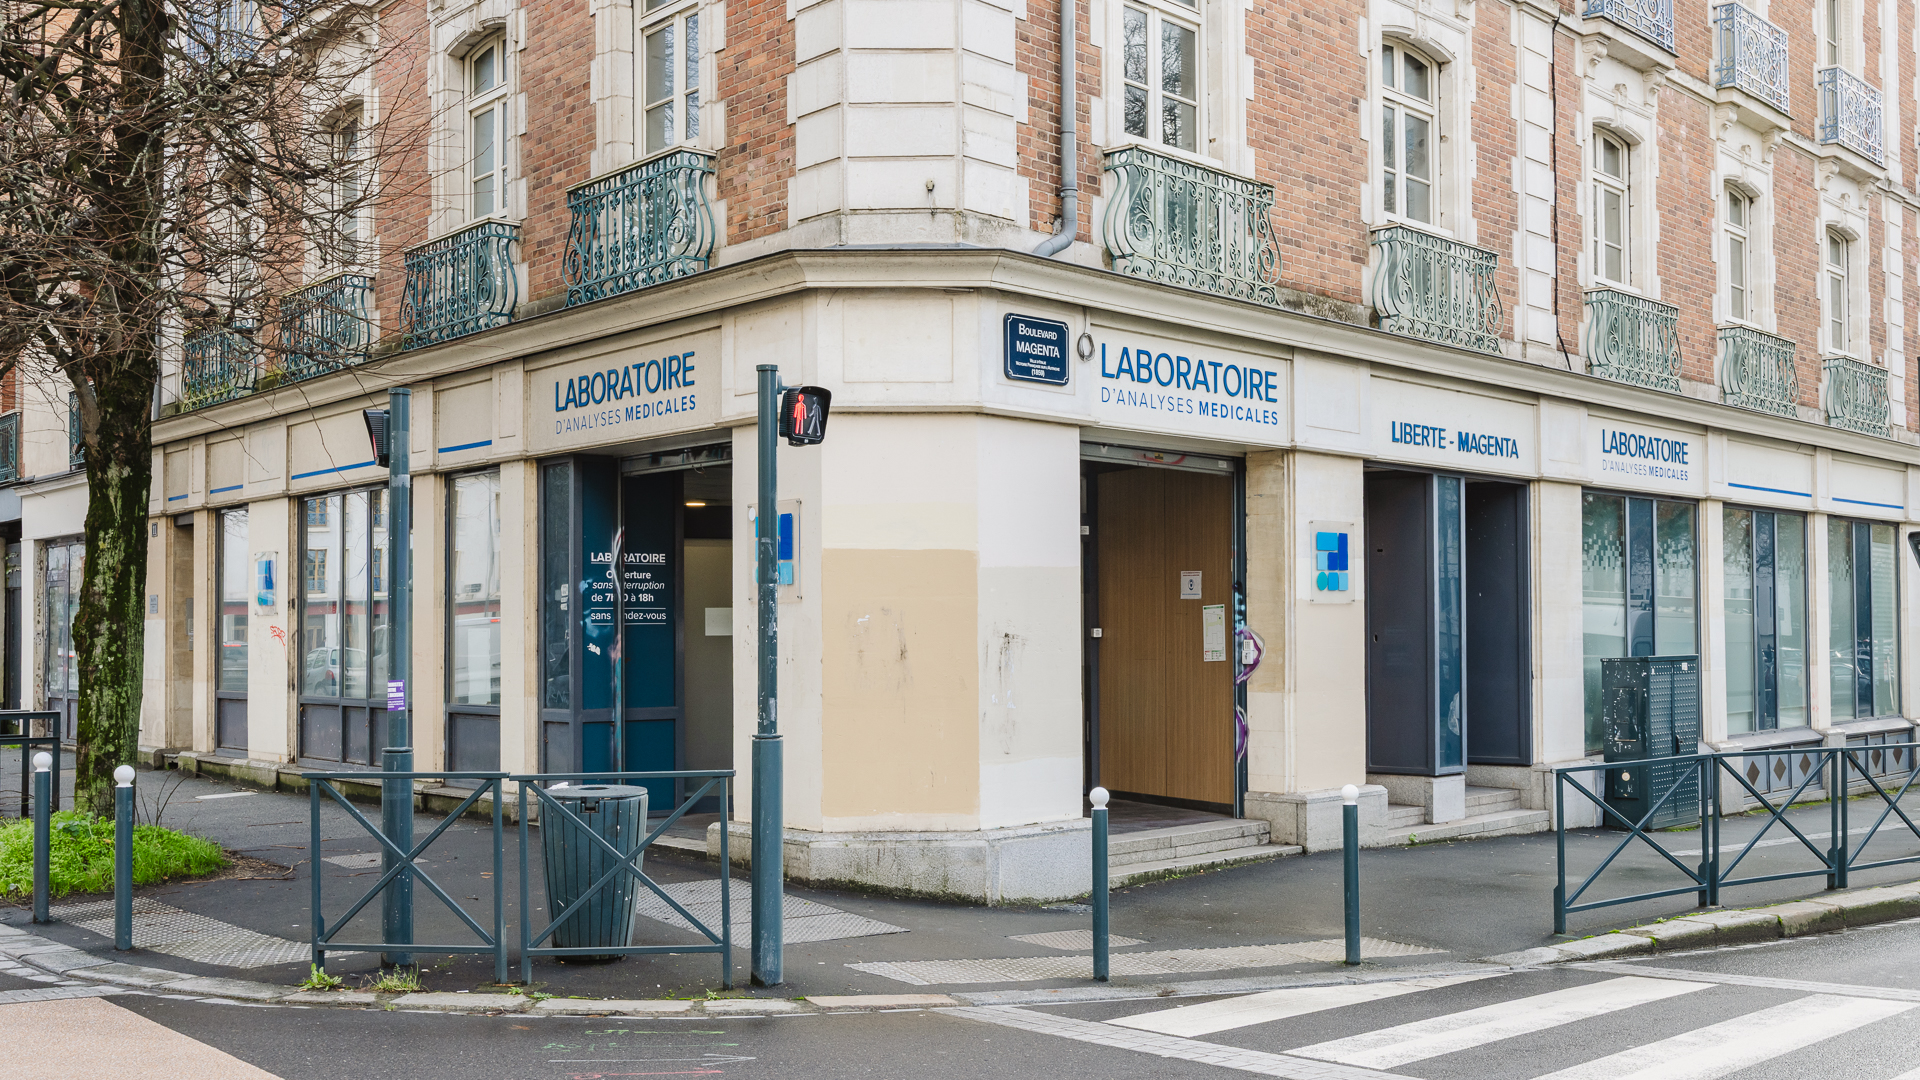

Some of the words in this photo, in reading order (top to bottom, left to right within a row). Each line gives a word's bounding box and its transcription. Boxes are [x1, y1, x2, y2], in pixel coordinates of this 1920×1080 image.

[1016, 340, 1060, 358] MAGENTA
[555, 351, 695, 412] LABORATOIRE
[1101, 343, 1278, 403] LABORATOIRE
[556, 409, 621, 434] D'ANALYSES
[625, 394, 696, 422] MEDICALES
[1101, 387, 1194, 414] D'ANALYSES
[1199, 400, 1278, 425] MEDICALES
[1391, 420, 1447, 449] LIBERTE
[1457, 431, 1519, 459] MAGENTA
[1602, 428, 1689, 465] LABORATOIRE
[1602, 459, 1647, 476] D'ANALYSES
[1648, 465, 1689, 481] MEDICALES
[591, 552, 666, 563] LABRATOIRE
[606, 570, 652, 579] Oerture
[592, 581, 614, 590] sans
[623, 581, 665, 591] terruption
[591, 593, 603, 602] de
[630, 593, 636, 602] à
[638, 593, 654, 602] 18h
[591, 612, 612, 620] sans
[624, 611, 667, 620] ndez-vous
